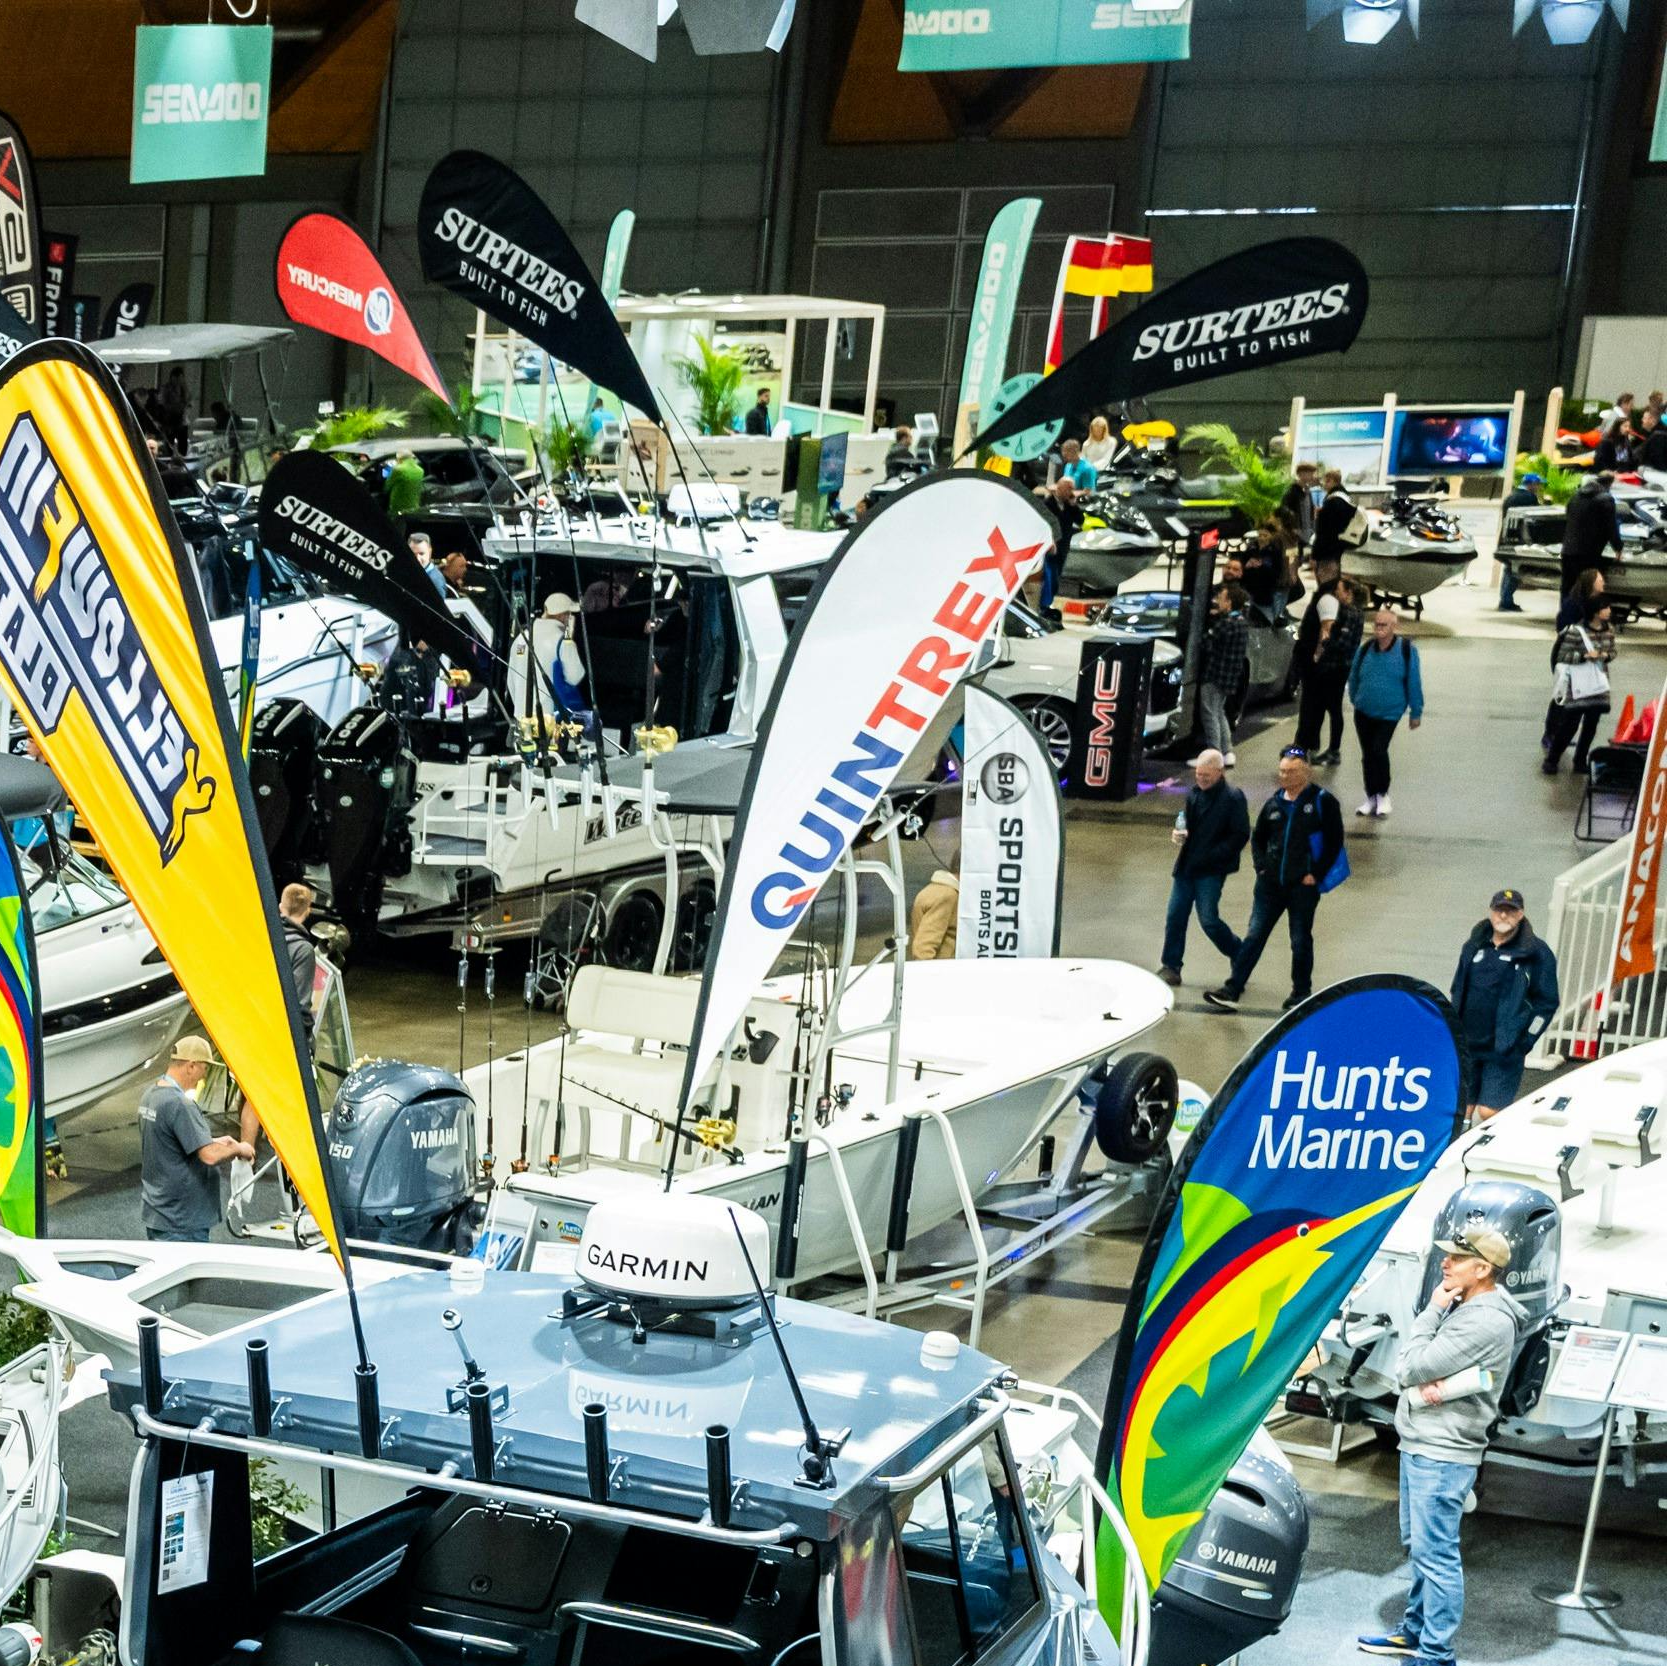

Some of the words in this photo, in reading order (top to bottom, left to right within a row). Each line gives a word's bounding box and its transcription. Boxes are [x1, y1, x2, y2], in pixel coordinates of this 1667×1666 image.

[434, 207, 584, 314] SURTEES
[459, 260, 496, 292] BUILT
[500, 284, 516, 307] TO
[521, 297, 548, 327] FISH
[1133, 282, 1349, 362] SURTEES
[1174, 348, 1228, 372] BUILT
[1238, 340, 1260, 357] TO
[1269, 329, 1311, 350] FISH
[274, 495, 395, 572] SURTEES
[290, 532, 320, 555] BUILT
[323, 549, 336, 564] TO
[338, 559, 364, 580] FISH
[750, 526, 1044, 930] QUINTREX
[1084, 659, 1122, 788] GMC
[994, 754, 1019, 804] SBA
[978, 888, 993, 938] BOATS
[994, 816, 1024, 958] SPORTS
[1269, 1050, 1432, 1112] Hunts
[329, 1141, 355, 1160] 150
[410, 1128, 459, 1149] YAMAHA
[1247, 1111, 1426, 1171] Marine
[588, 1244, 709, 1281] GARMIN
[1215, 1547, 1277, 1576] YAMAHA
